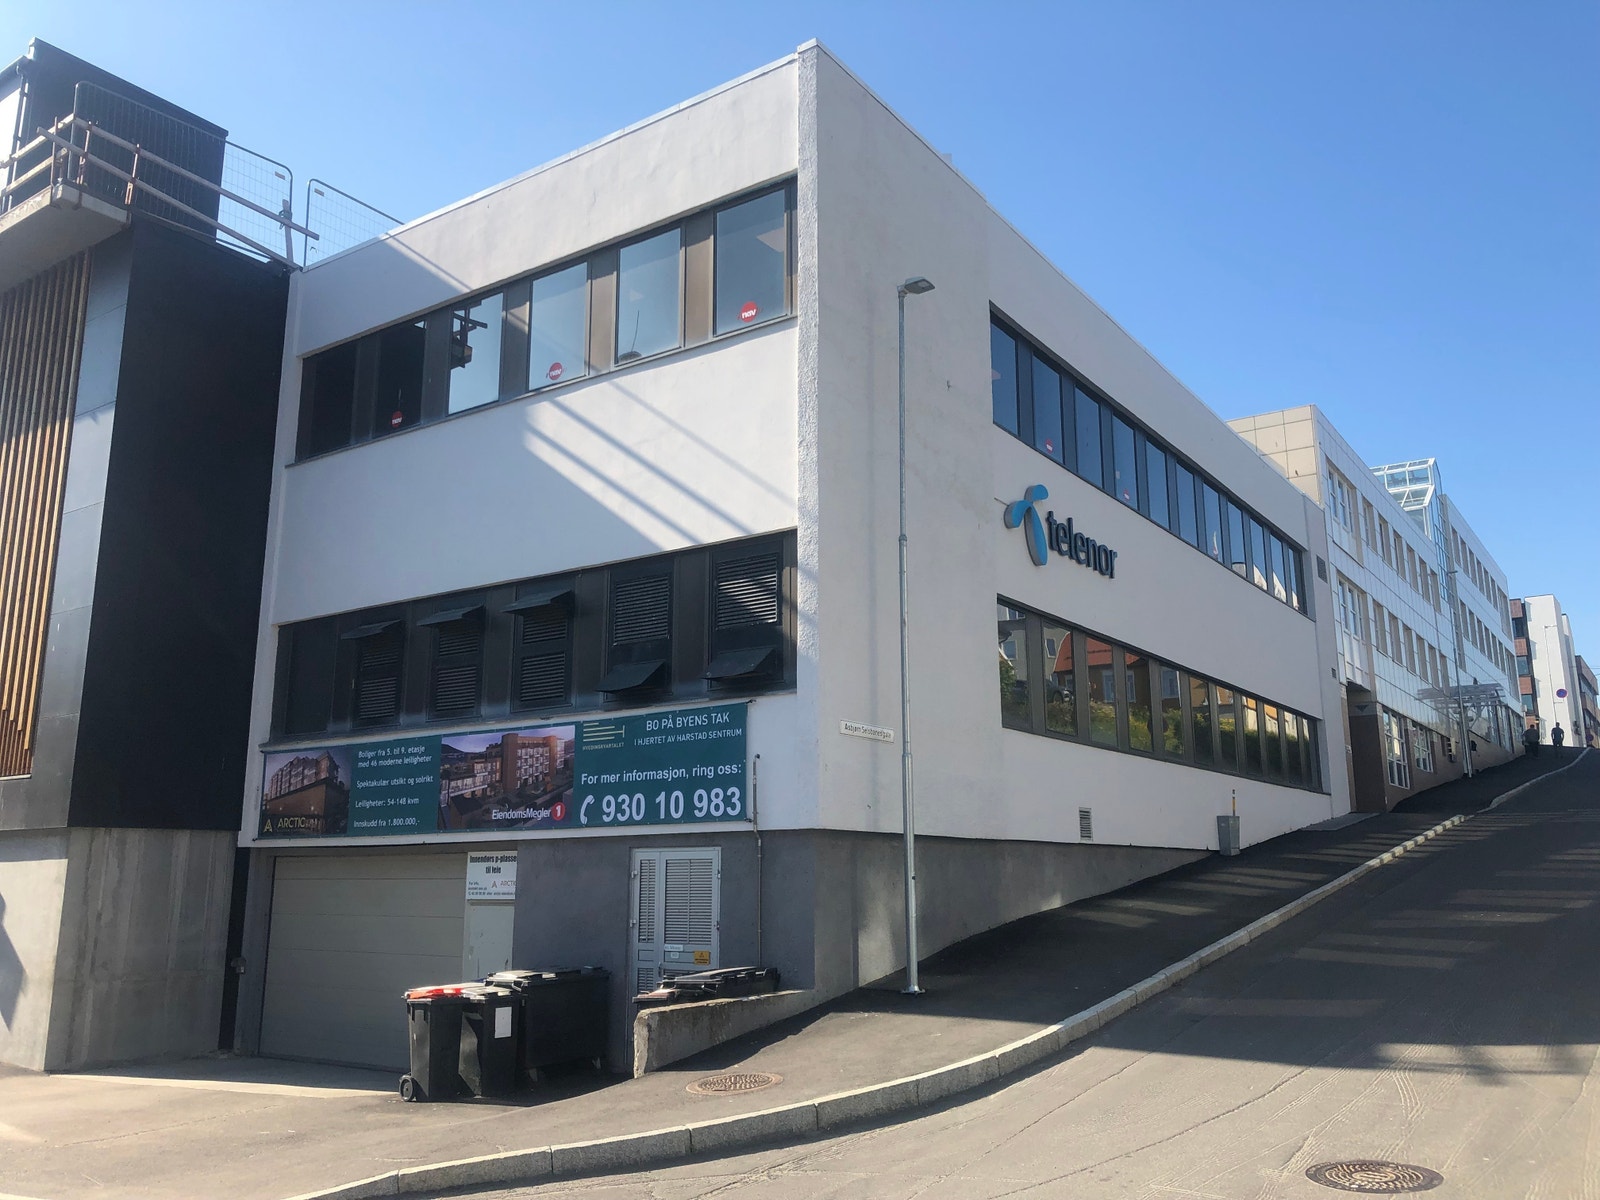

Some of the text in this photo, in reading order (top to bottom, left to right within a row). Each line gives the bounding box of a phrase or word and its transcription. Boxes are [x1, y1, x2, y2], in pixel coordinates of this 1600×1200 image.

[741, 309, 757, 319] nav
[1045, 510, 1118, 579] telenor
[646, 712, 730, 731] BO PÅ BYENS TAK
[637, 735, 666, 746] HJERTET
[666, 734, 676, 743] AV
[676, 731, 708, 742] HARSTAD
[708, 728, 742, 739] SENTRUM
[358, 750, 377, 759] Boliger
[377, 749, 386, 757] fra
[387, 747, 393, 756] 5.
[408, 745, 426, 755] etasje
[358, 760, 370, 768] med
[378, 758, 403, 766] moderne
[403, 755, 433, 765] leiligheter
[581, 763, 742, 785] For mer informasjon, ring oss:
[356, 775, 434, 789] Spektakulær utsikt og solrikt
[355, 799, 386, 809] Leiligheter:
[407, 797, 420, 805] kvm
[602, 786, 742, 823] 930 10 983
[491, 808, 552, 821] EiendomsMegler
[353, 819, 378, 828] Innskudd
[378, 819, 387, 827] fra
